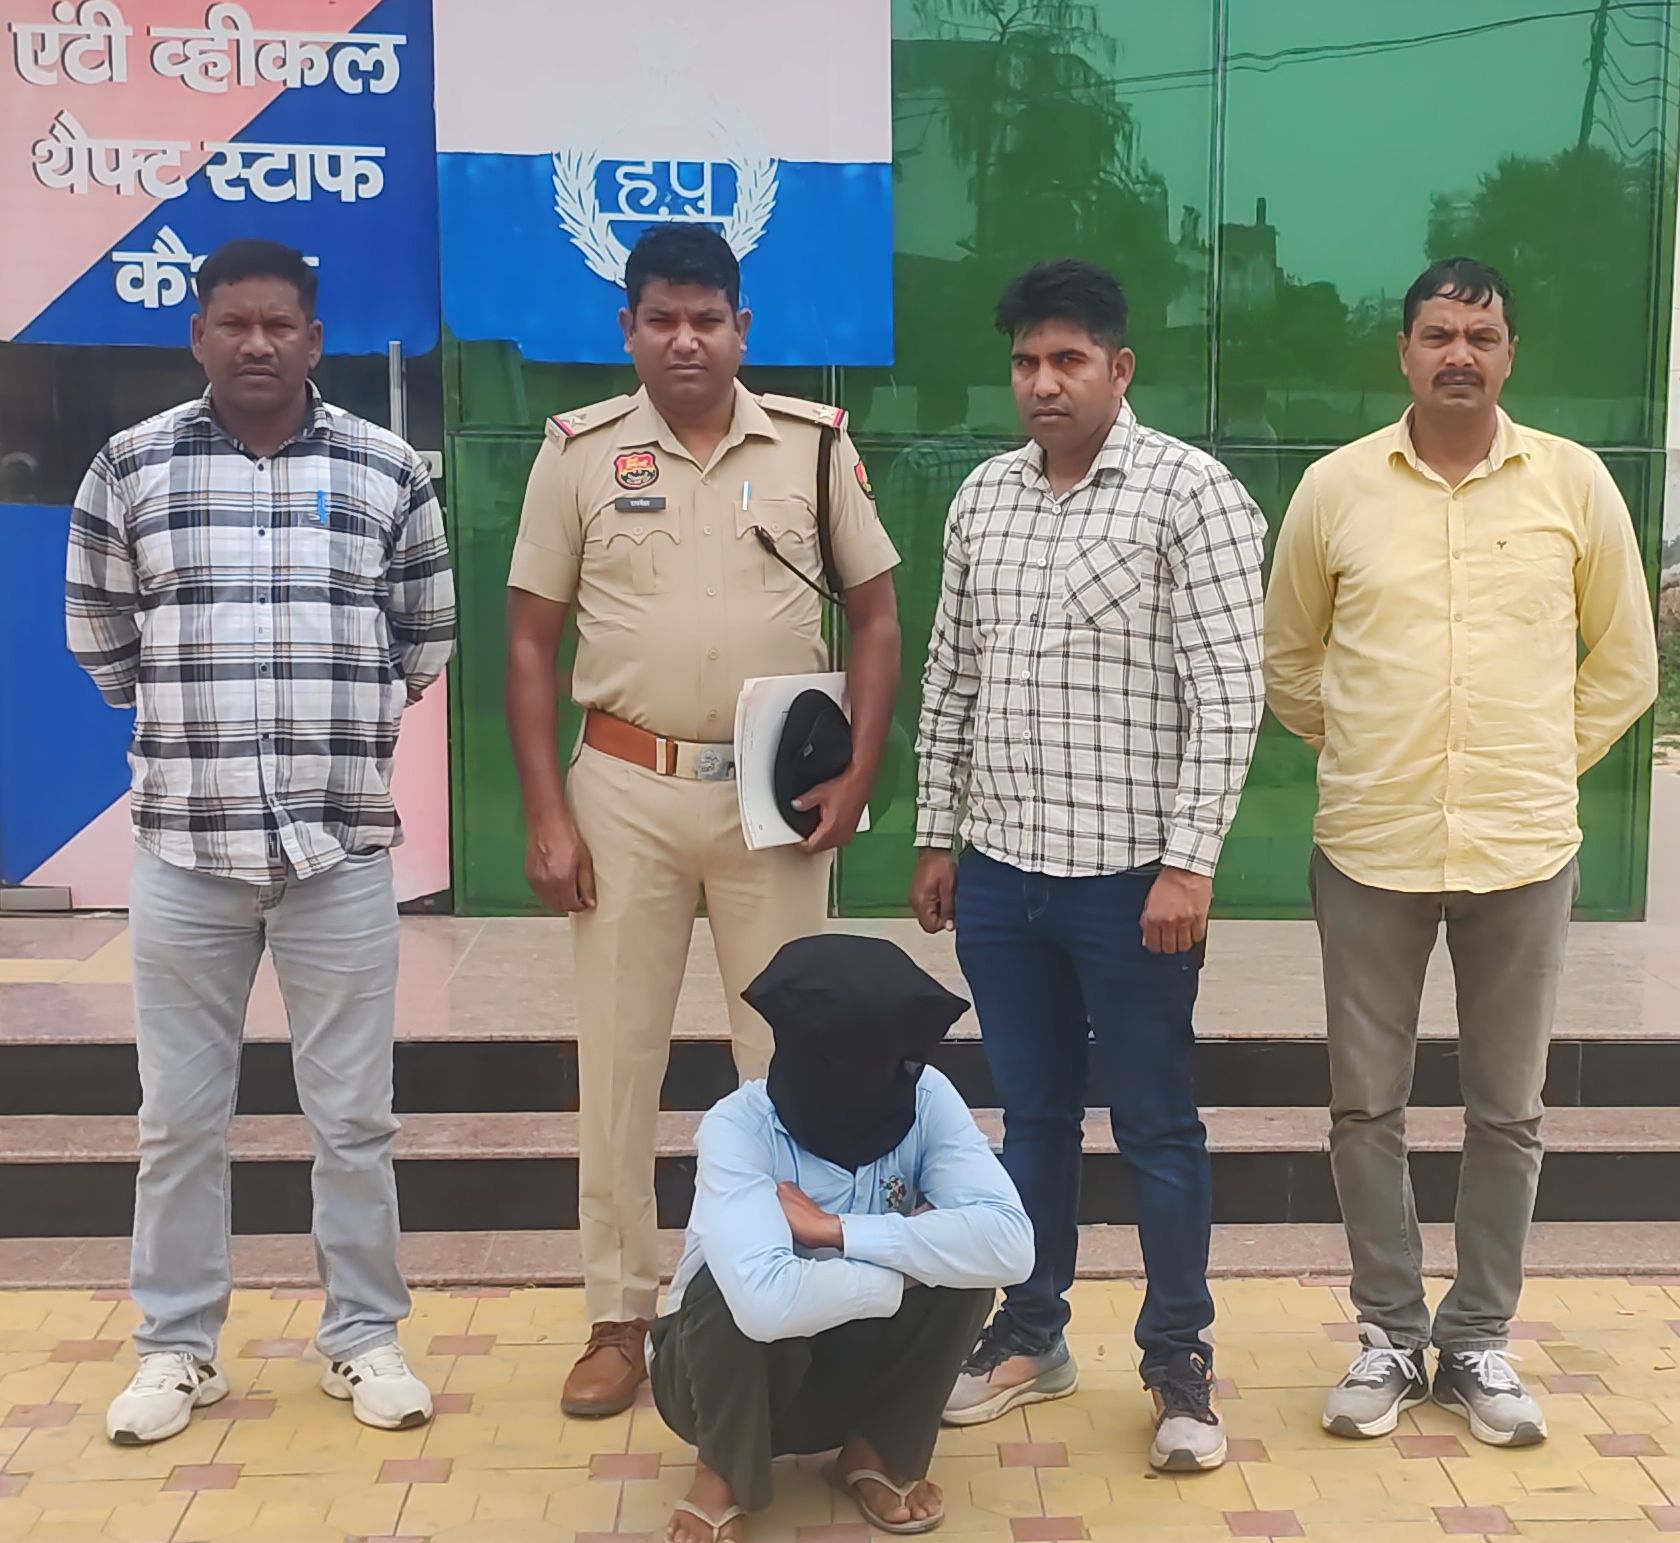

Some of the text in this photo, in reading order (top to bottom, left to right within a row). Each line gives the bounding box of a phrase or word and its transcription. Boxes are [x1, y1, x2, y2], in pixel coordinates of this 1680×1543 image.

[8, 0, 407, 95] एंटी व्हीकल
[32, 109, 386, 203] थैफ्ट स्टाफ
[111, 225, 320, 309] कै
